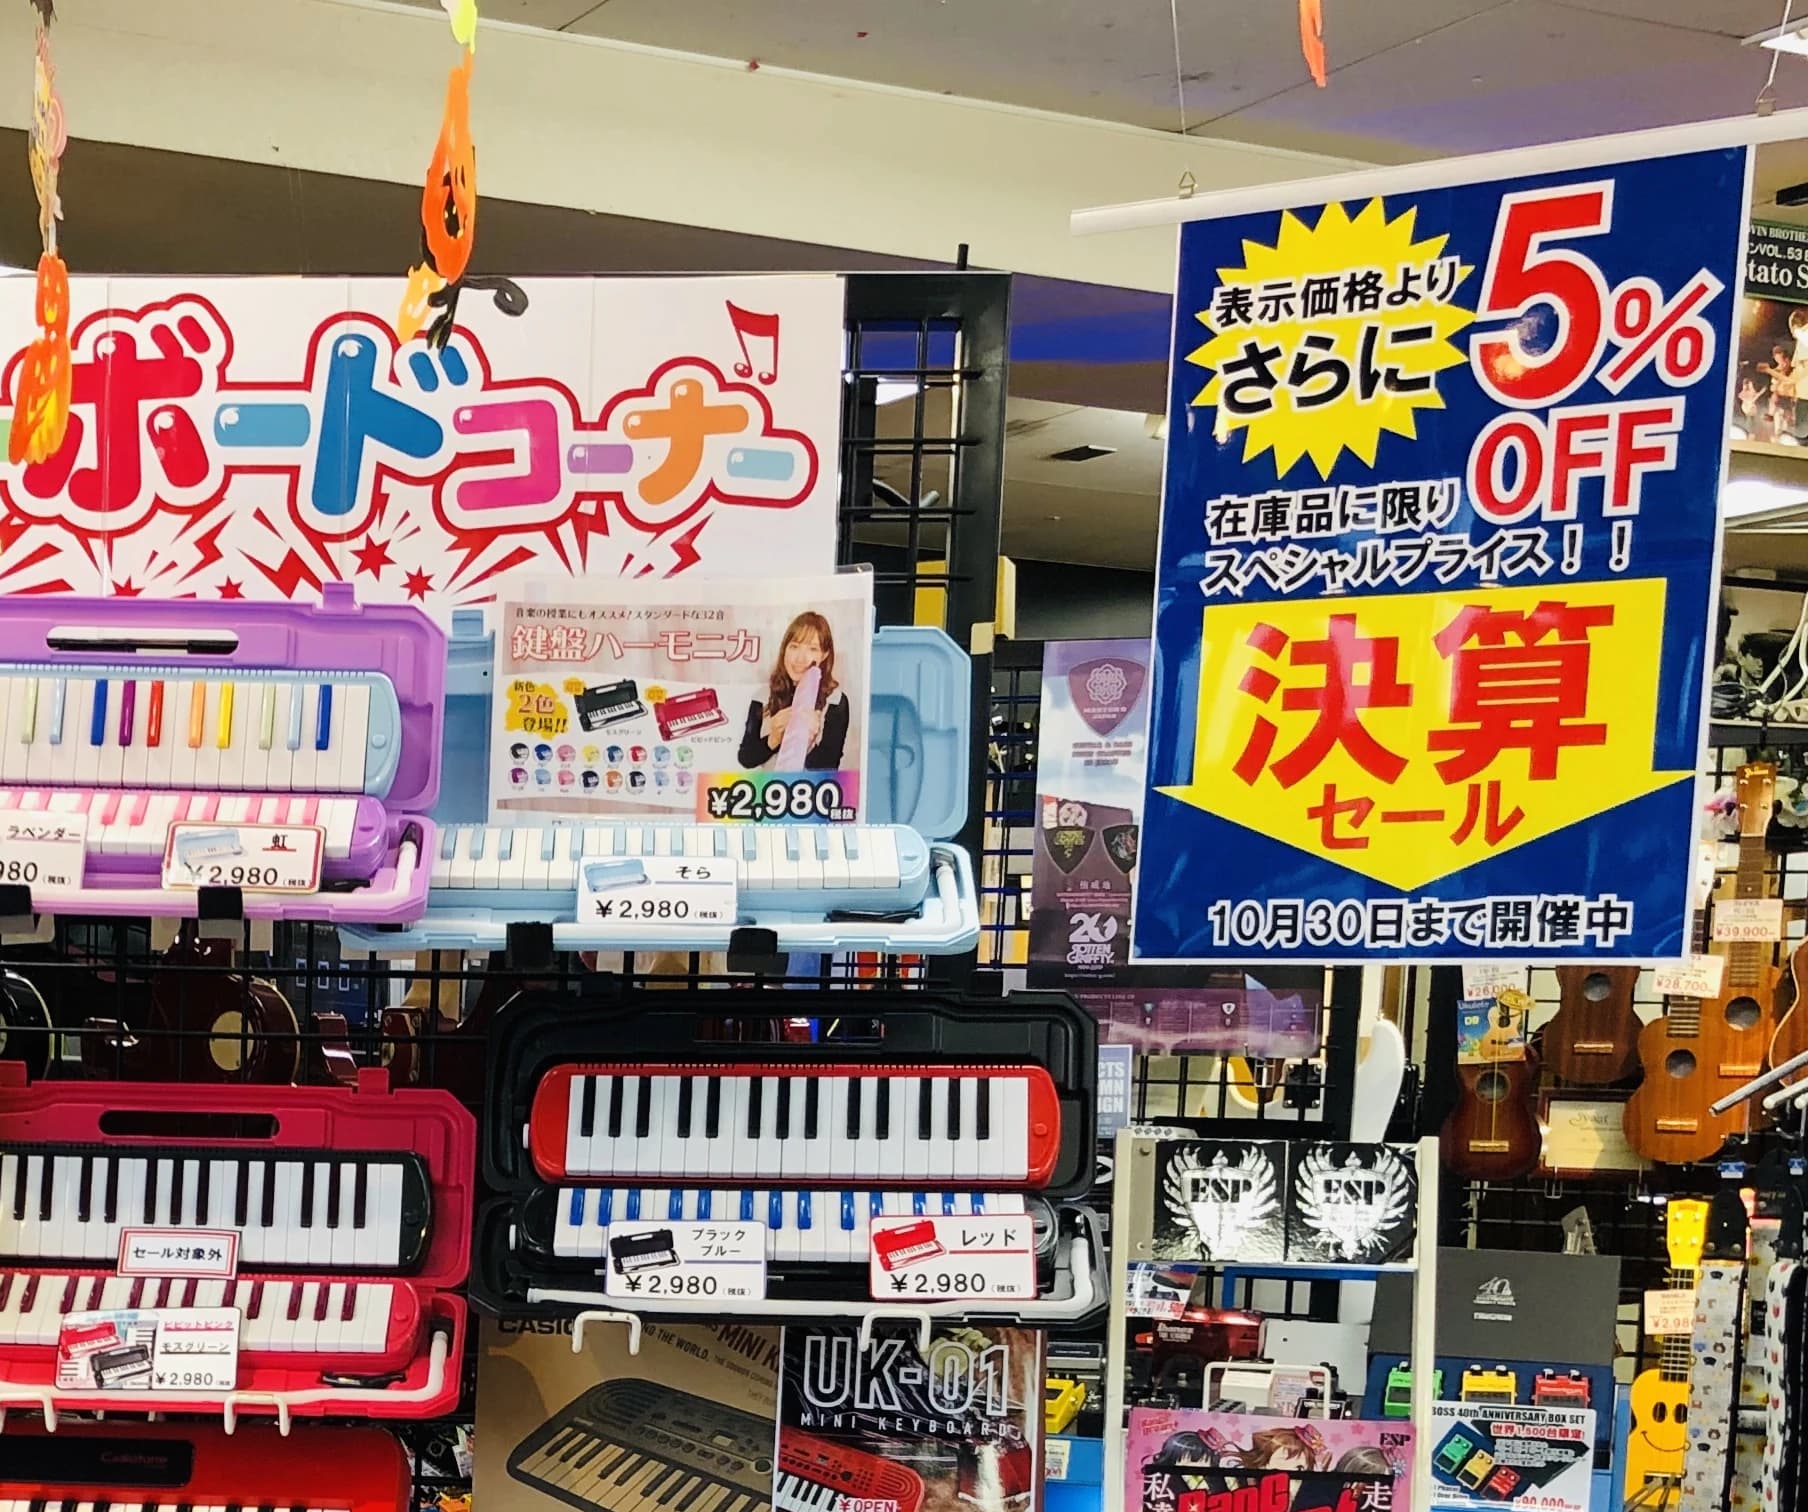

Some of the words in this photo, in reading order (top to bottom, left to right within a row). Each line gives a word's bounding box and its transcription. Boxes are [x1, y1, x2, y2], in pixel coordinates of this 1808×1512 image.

[1214, 260, 1457, 326] 表示価格より
[1474, 184, 1716, 406] 5%
[1221, 322, 1434, 415] さらに
[1472, 404, 1680, 520] OFF
[1209, 480, 1458, 543] 在庫品に限り
[512, 624, 761, 664] 鍵盤ハーモニカ
[1233, 602, 1613, 788] 決算
[709, 780, 840, 820] ¥2,980
[1308, 780, 1524, 849] セール
[7, 824, 82, 841] ラベンダー
[270, 833, 289, 851] 虹
[676, 865, 713, 880] そら
[595, 899, 690, 920] ¥2,980
[1211, 898, 1631, 947] 10月30日まで開催中
[1190, 1178, 1253, 1204] ESP
[1323, 1179, 1386, 1206] ESP
[692, 1228, 747, 1242] ブラック
[960, 1227, 1018, 1248] レッド
[133, 1246, 223, 1262] セール対象外
[700, 1244, 741, 1257] ブルー
[624, 1275, 718, 1296] ¥2,980
[890, 1272, 987, 1294] ¥2,980
[155, 1372, 214, 1386] ¥2,980
[803, 1334, 1010, 1417] UK-01
[800, 1412, 856, 1430] MINI
